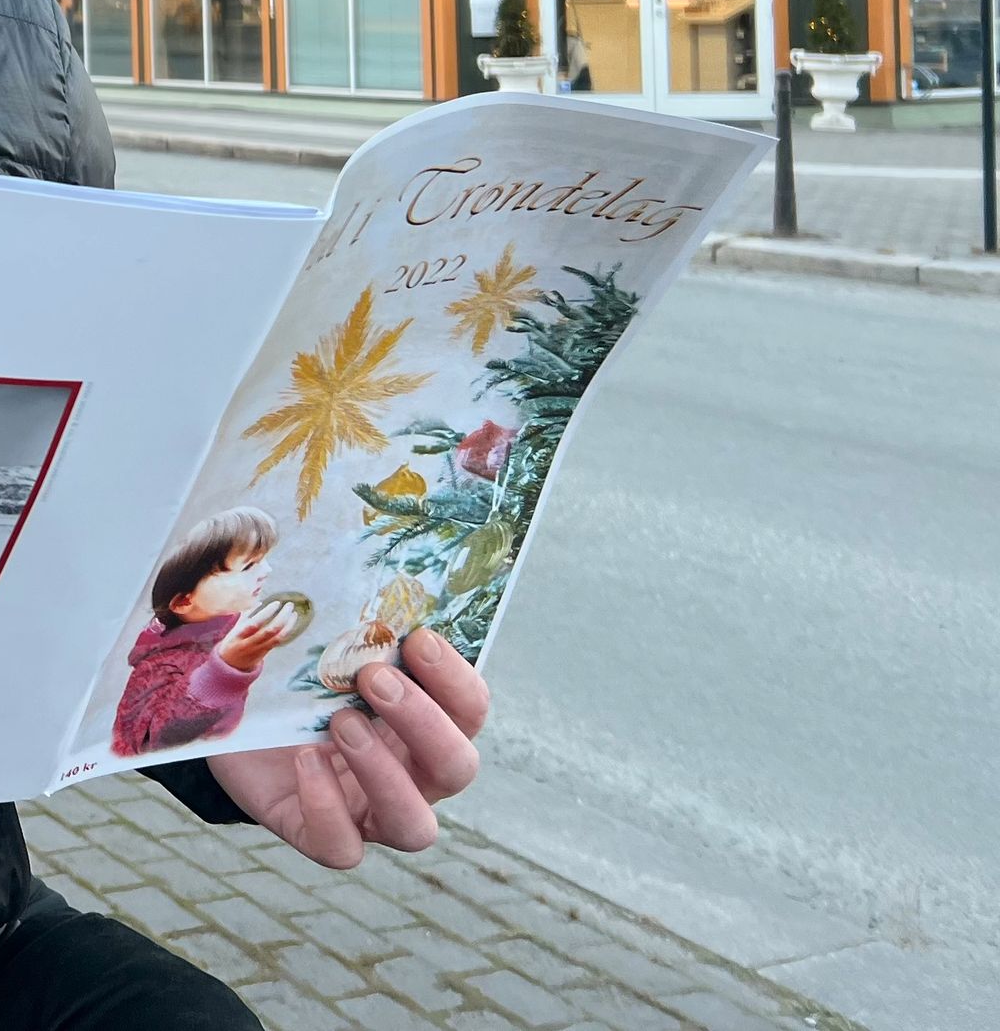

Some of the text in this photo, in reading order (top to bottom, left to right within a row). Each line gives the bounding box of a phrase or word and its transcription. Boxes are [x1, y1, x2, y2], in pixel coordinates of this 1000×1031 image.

[399, 157, 703, 242] Trøndelag
[384, 254, 467, 294] 2022
[60, 762, 98, 781] 140 kr
